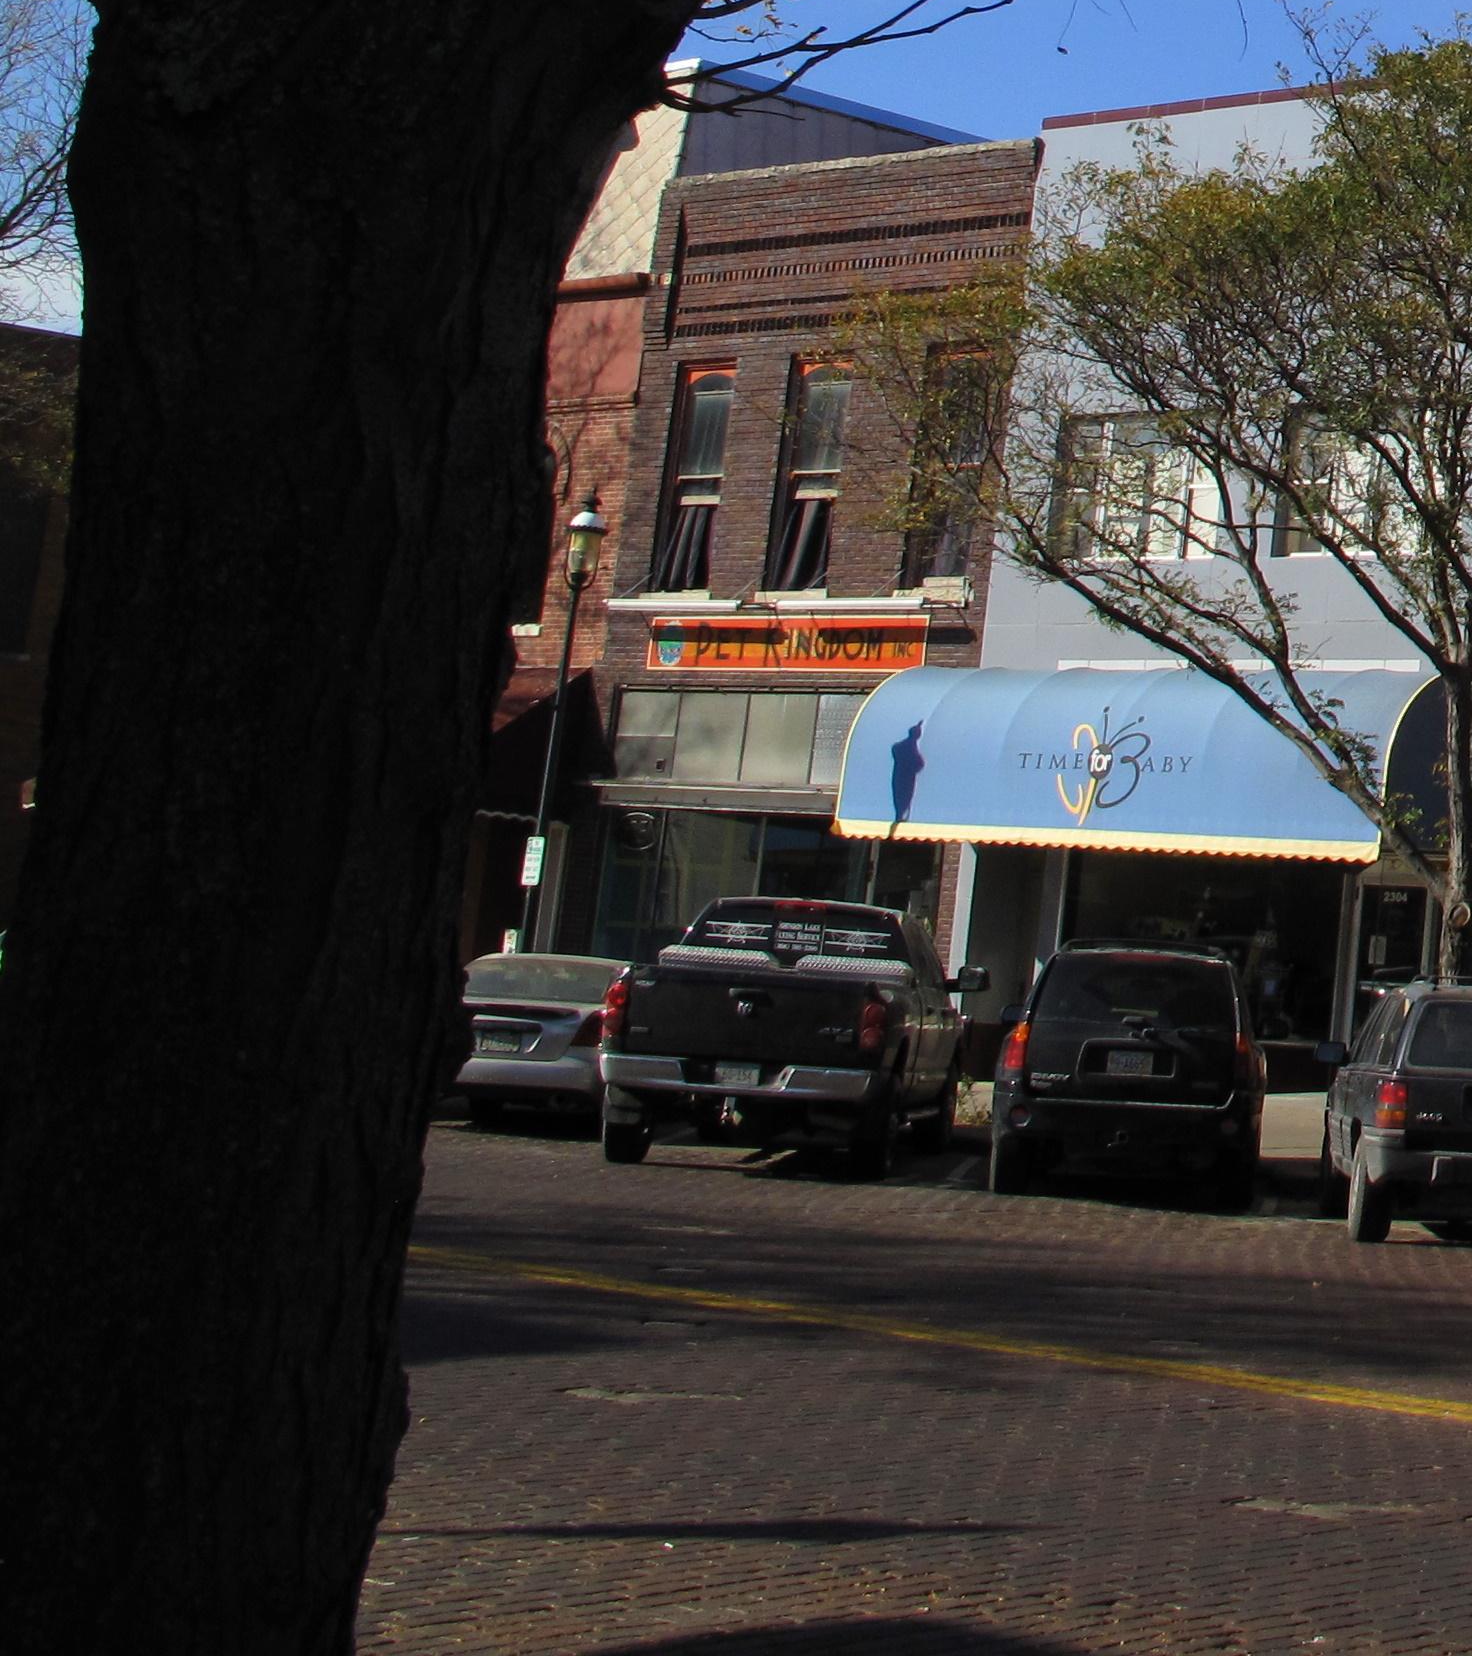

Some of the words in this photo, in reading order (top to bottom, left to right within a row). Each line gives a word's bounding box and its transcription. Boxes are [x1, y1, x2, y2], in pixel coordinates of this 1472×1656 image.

[695, 621, 750, 666] PET
[763, 619, 884, 667] KINGDOM
[1018, 752, 1084, 770] TIME
[1090, 748, 1112, 772] for
